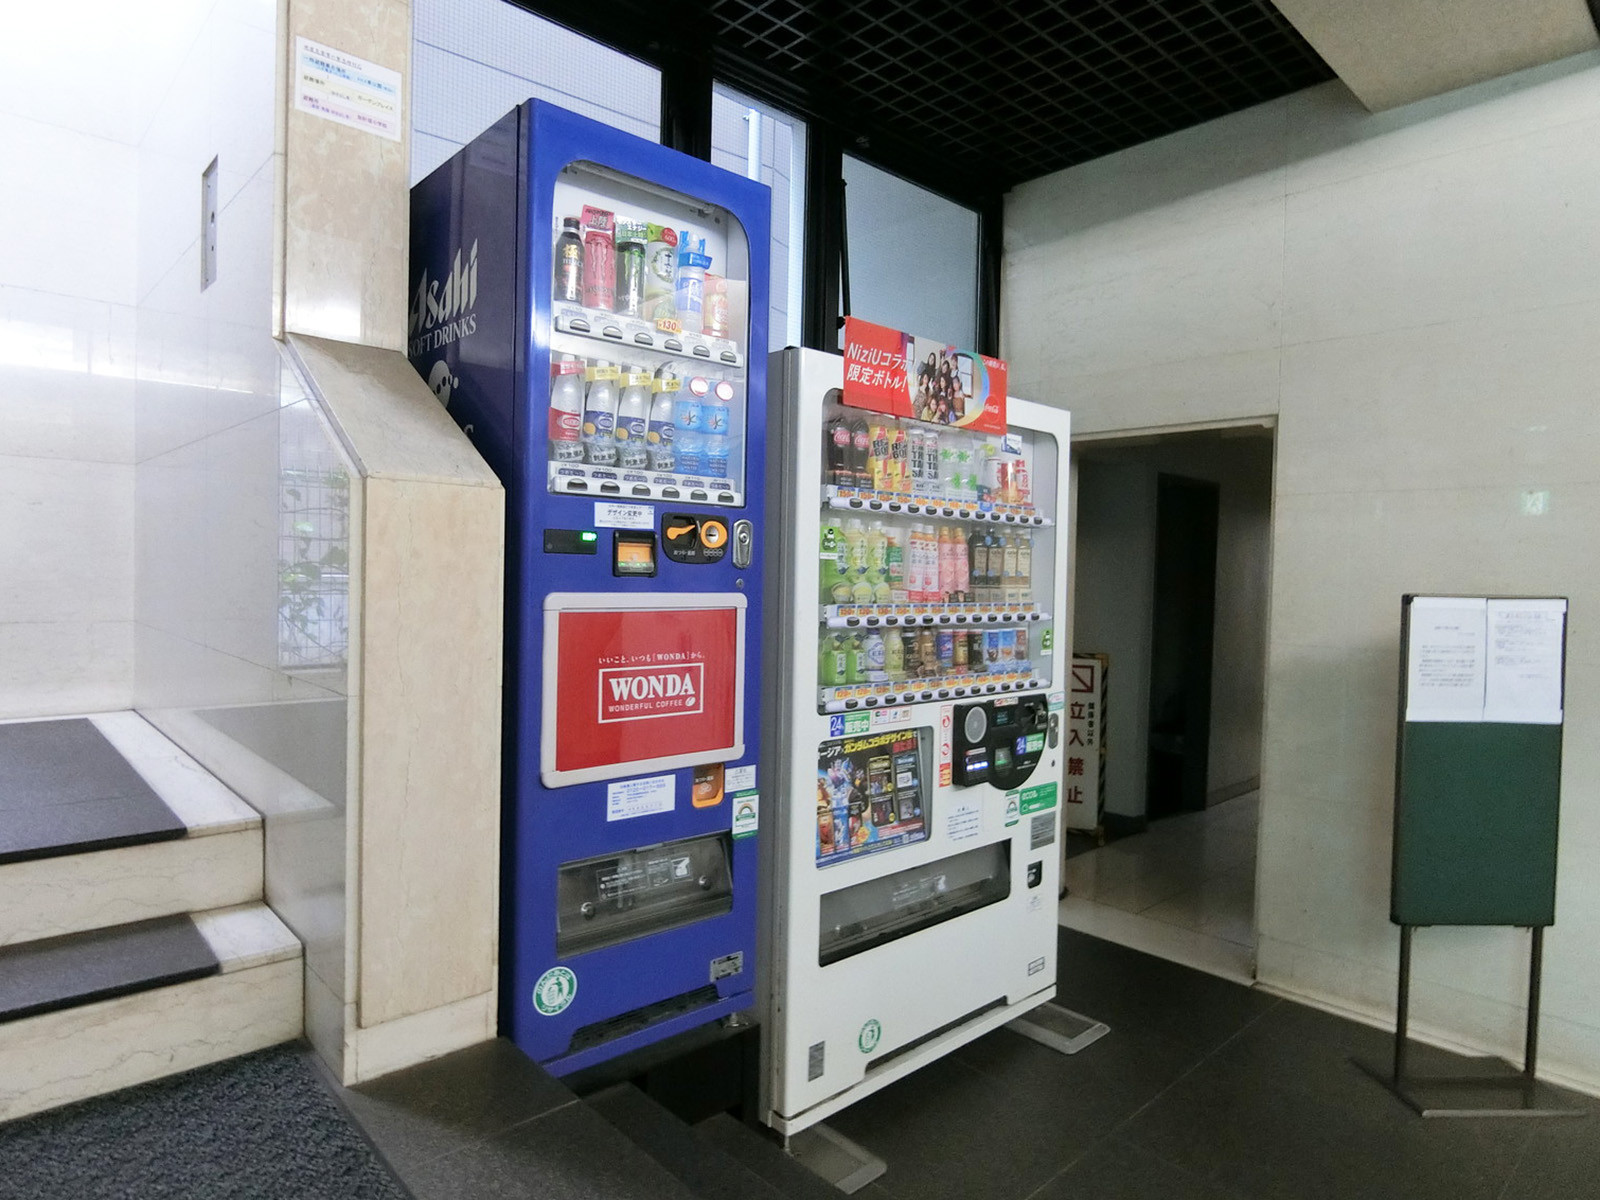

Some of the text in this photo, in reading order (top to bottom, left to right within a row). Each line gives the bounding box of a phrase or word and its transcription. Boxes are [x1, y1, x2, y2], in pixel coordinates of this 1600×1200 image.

[409, 237, 478, 336] Asahi
[433, 313, 477, 350] DRINKS
[608, 699, 683, 713] WONDERFUL COFFEE
[609, 673, 696, 702] WONDA
[1087, 702, 1095, 746] 関係者以外
[1066, 701, 1086, 805] 立入禁止
